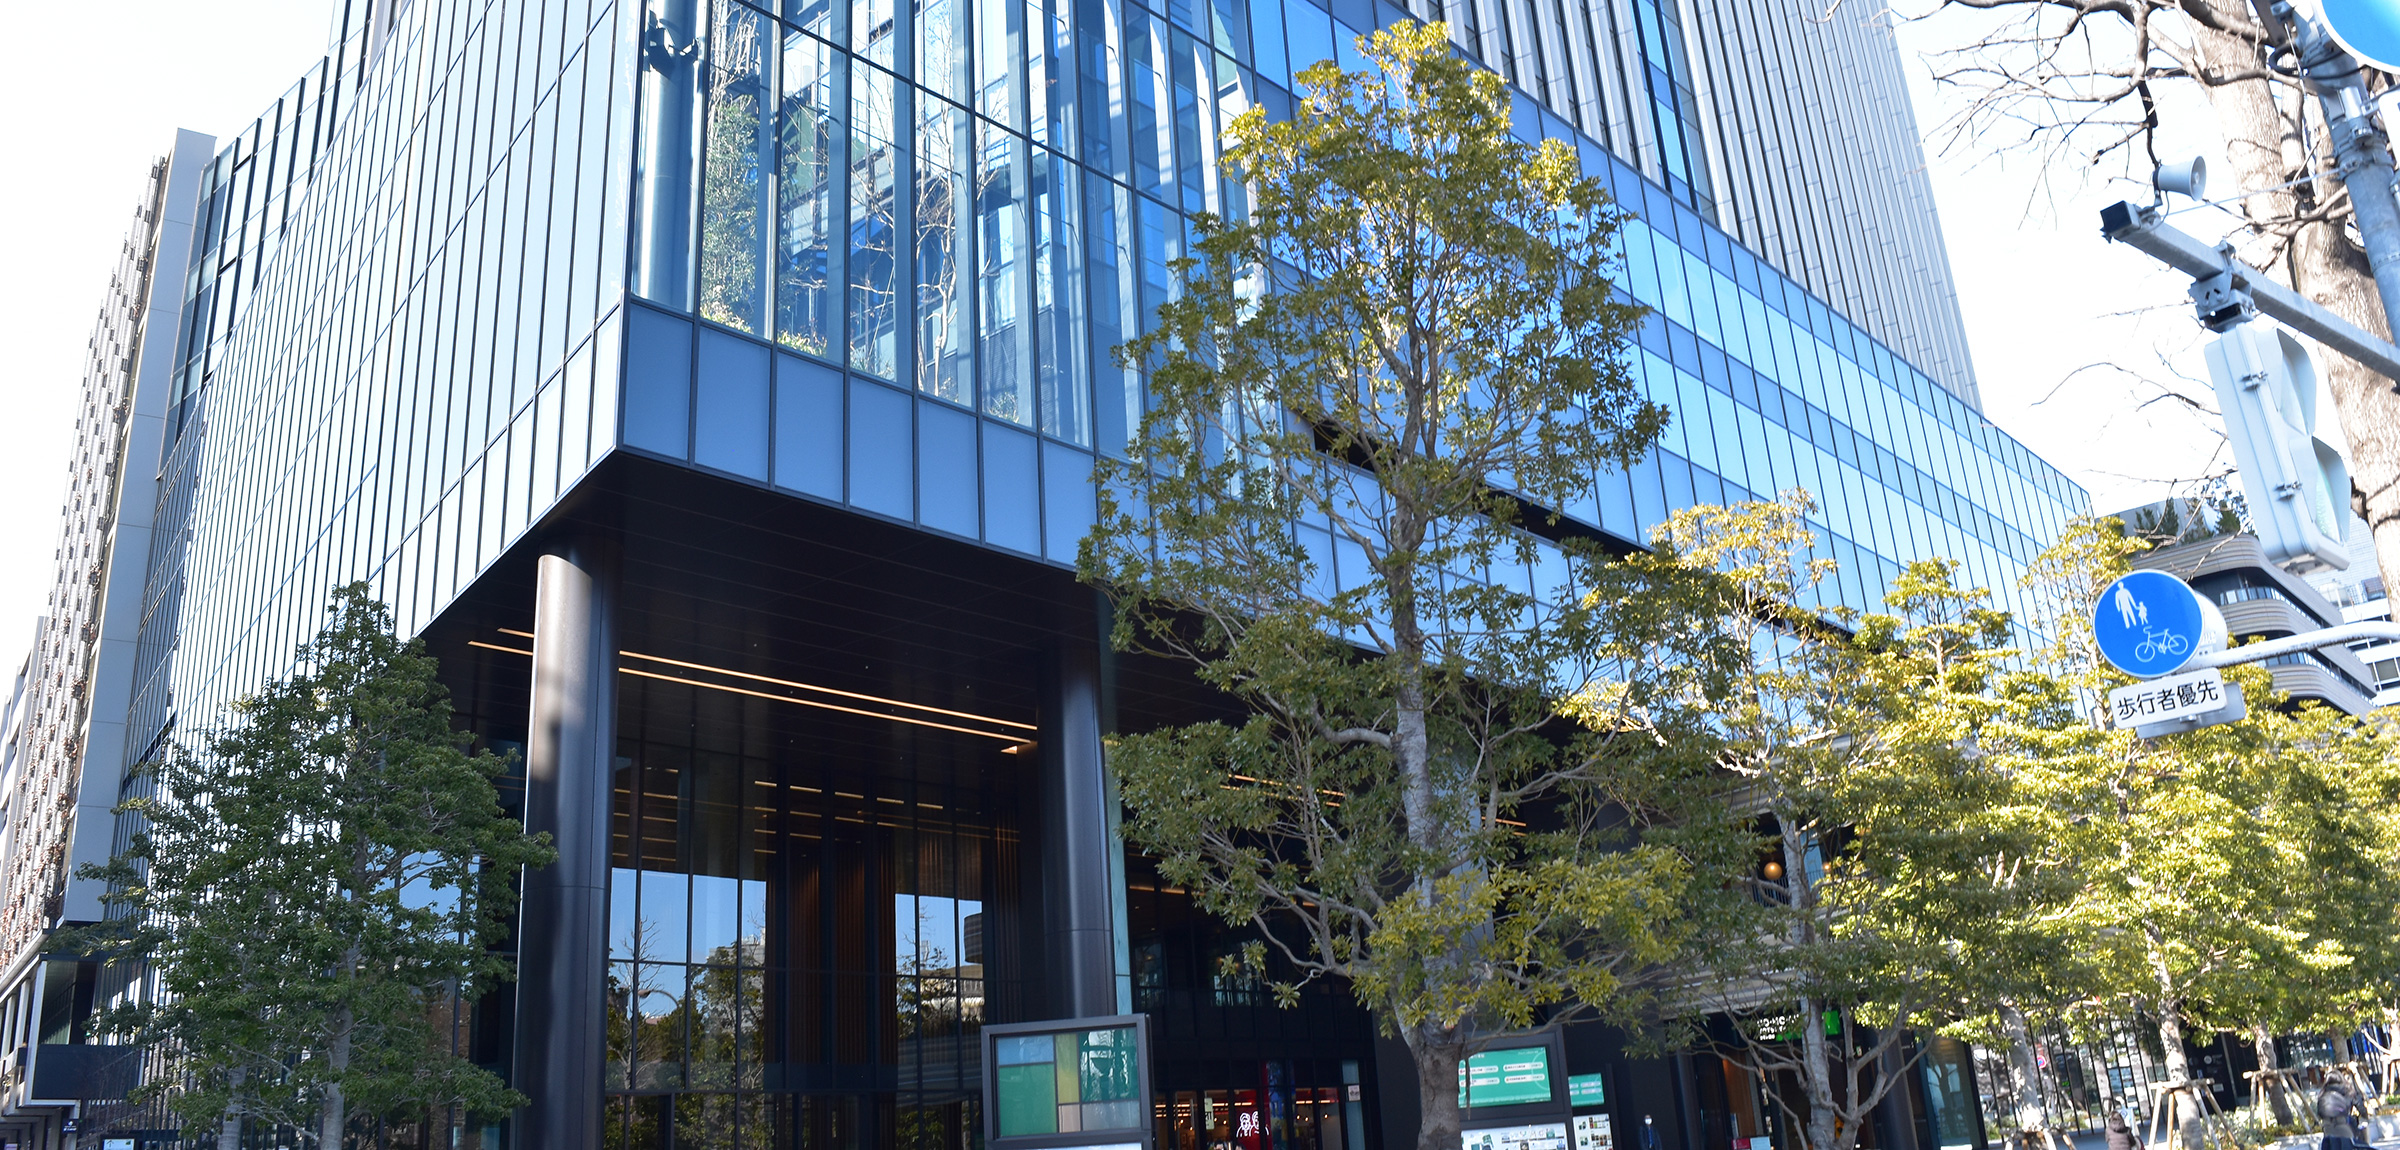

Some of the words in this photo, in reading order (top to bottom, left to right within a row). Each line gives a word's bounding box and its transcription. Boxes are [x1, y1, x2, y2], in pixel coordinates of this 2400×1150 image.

[2117, 679, 2219, 720] 歩行者優先
